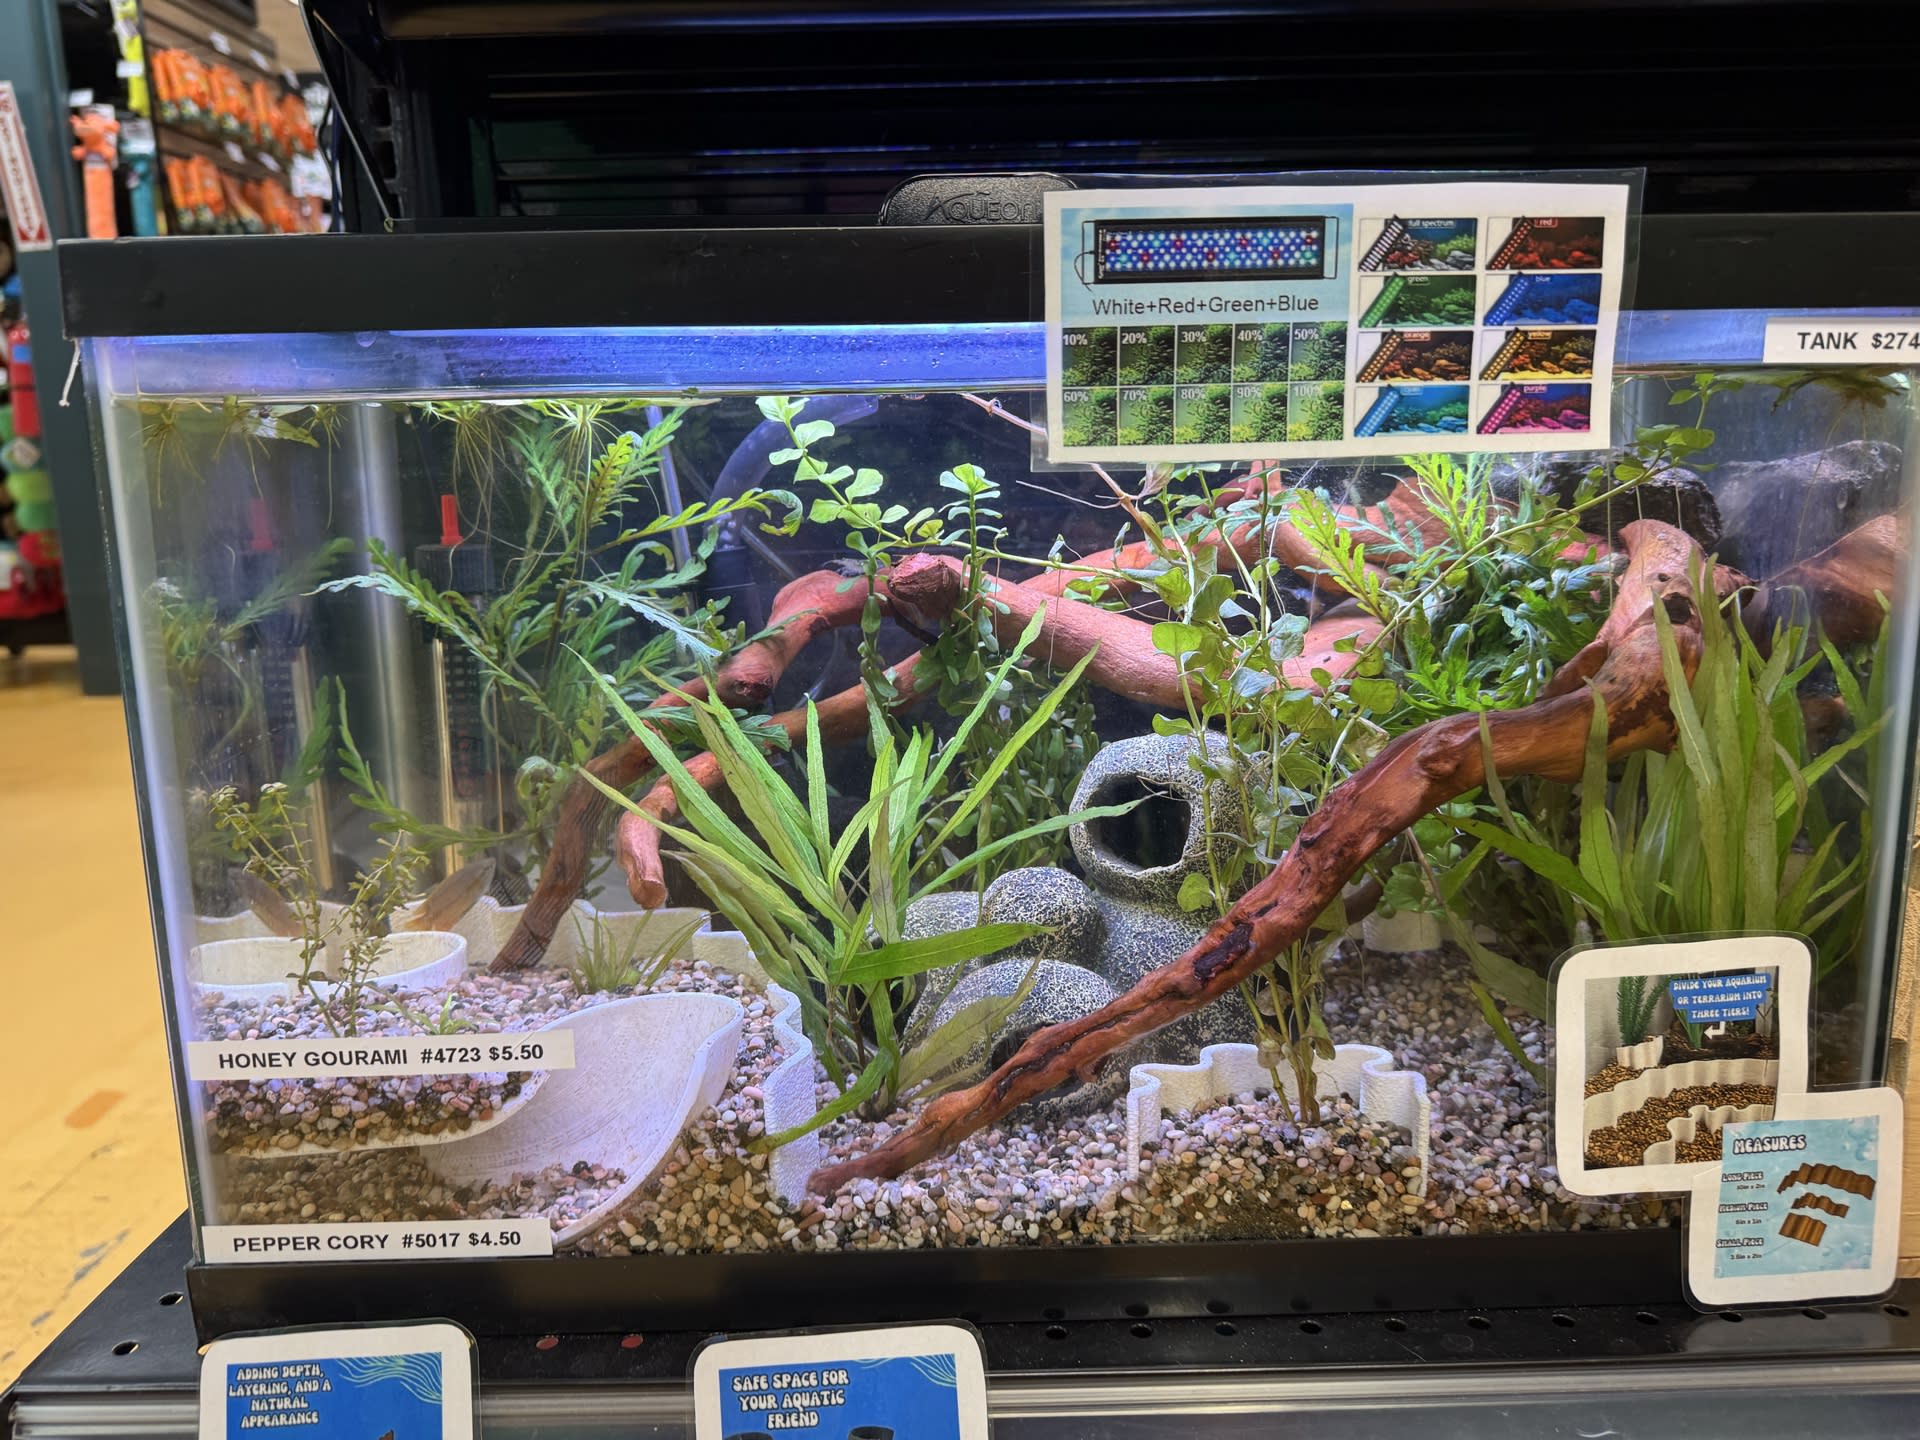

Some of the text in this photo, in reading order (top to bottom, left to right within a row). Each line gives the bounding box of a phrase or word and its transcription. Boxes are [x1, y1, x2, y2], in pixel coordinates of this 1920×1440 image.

[1421, 220, 1455, 229] spectrum
[1407, 276, 1429, 284] green
[1092, 295, 1320, 315] White+Red+Green+Blue
[1062, 333, 1088, 346] 10%
[1121, 332, 1147, 345] 20%
[1181, 330, 1207, 343] 30%
[1237, 329, 1263, 342] 40%
[1294, 328, 1319, 341] 50%
[1797, 332, 1920, 350] TANK $274
[1063, 390, 1089, 403] 60%
[1122, 389, 1148, 402] 70%
[1180, 388, 1206, 400] 80%
[1236, 386, 1262, 399] 90%
[1293, 385, 1322, 398] 100%
[1673, 975, 1767, 991] DIVIDE YOUR AQUARIUM
[1677, 990, 1763, 1005] OR TERRARIUM INTO
[1691, 1006, 1750, 1019] THREE TIERS!
[218, 1043, 544, 1070] HONEY GOURAMI #4723 $5.50
[1733, 1135, 1807, 1154] MEASURES
[233, 1231, 522, 1252] PEPPER CORY #5017 $4.50
[236, 1363, 325, 1382] ADDING DEPTH,
[732, 1368, 850, 1392] SAFE SPACE FOR
[228, 1378, 333, 1397] LAYERING, AND A
[251, 1396, 309, 1412] NATURAL
[740, 1389, 845, 1412] YOUR AQUATIC
[240, 1411, 319, 1429] APPEARANCE
[767, 1411, 819, 1430] FRIEND
